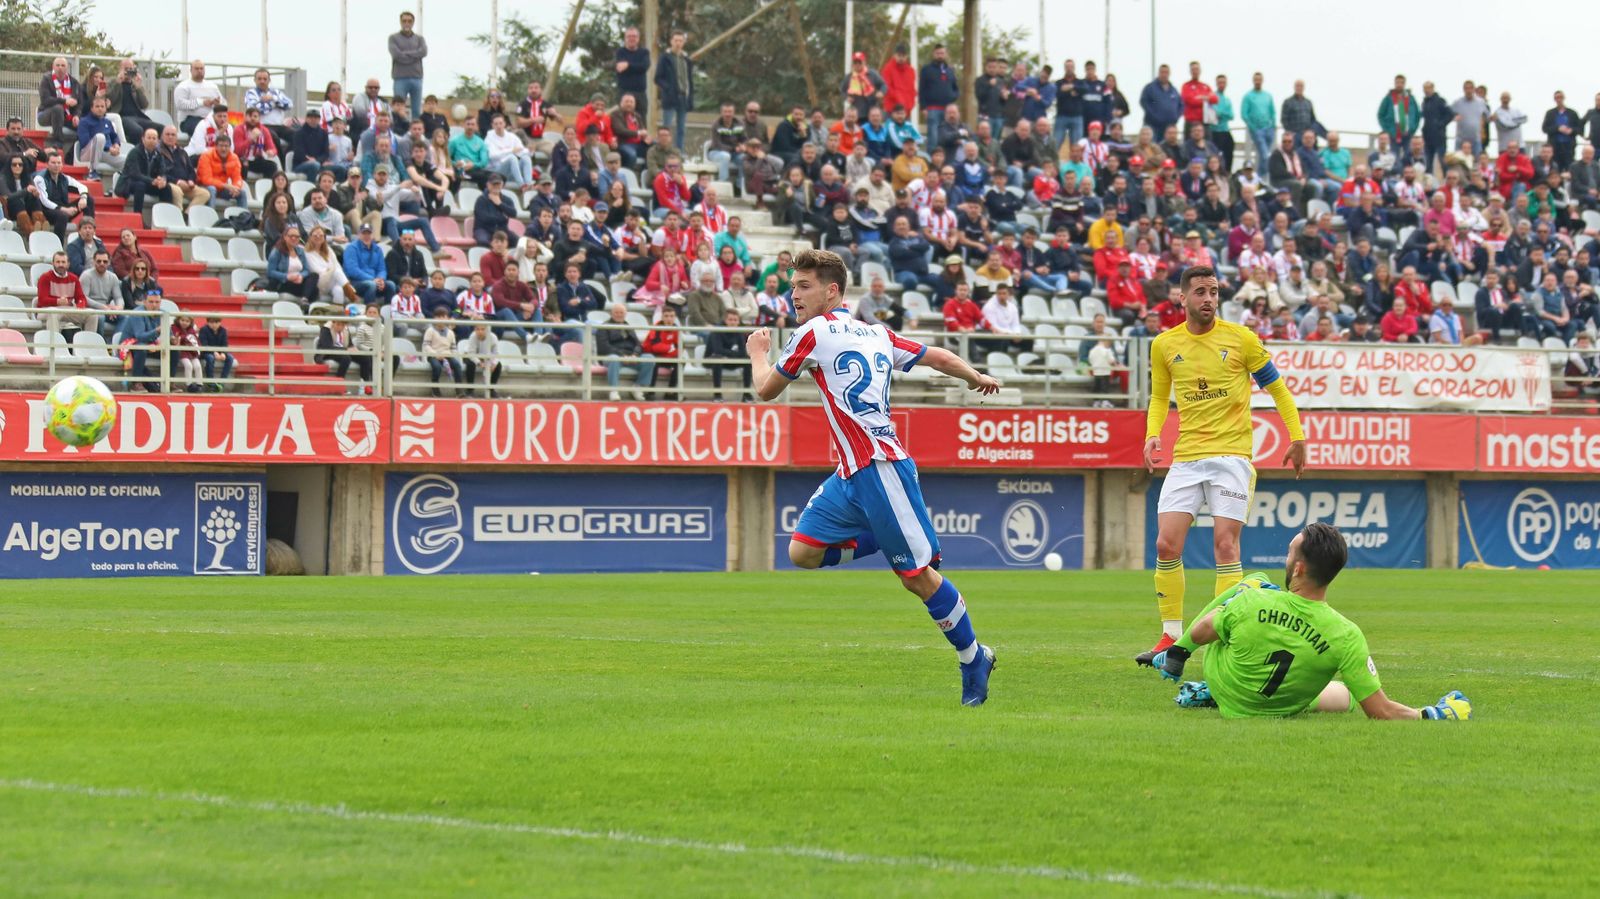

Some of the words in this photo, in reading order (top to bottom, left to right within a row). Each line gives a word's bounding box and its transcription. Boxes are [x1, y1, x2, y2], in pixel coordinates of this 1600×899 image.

[1269, 350, 1346, 370] GULLO
[1357, 352, 1476, 373] ALBIRROJO
[834, 350, 893, 417] 22
[1340, 376, 1368, 397] EN
[1378, 376, 1402, 397] EL
[1414, 379, 1516, 399] CORAZON
[25, 399, 316, 456] PDILLA
[460, 402, 580, 462] PURO
[599, 406, 780, 462] ESTRECHO
[958, 413, 1109, 443] Socialistas
[958, 447, 973, 459] de
[977, 447, 1034, 462] Algeciras
[11, 485, 86, 497] MOBILIARIO
[90, 486, 105, 496] DE
[110, 485, 161, 497] OFICINA
[199, 486, 245, 501] GRUPO
[246, 486, 258, 570] serviempresa
[481, 512, 706, 535] EUROGRUAS
[1519, 511, 1552, 544] PP
[3, 522, 180, 561] AlgeToner
[1574, 534, 1591, 550] de
[91, 562, 112, 571] todo
[114, 563, 135, 572] para
[137, 562, 145, 570] la
[147, 561, 179, 570] oficina.
[1258, 608, 1330, 656] CHRISTIAN
